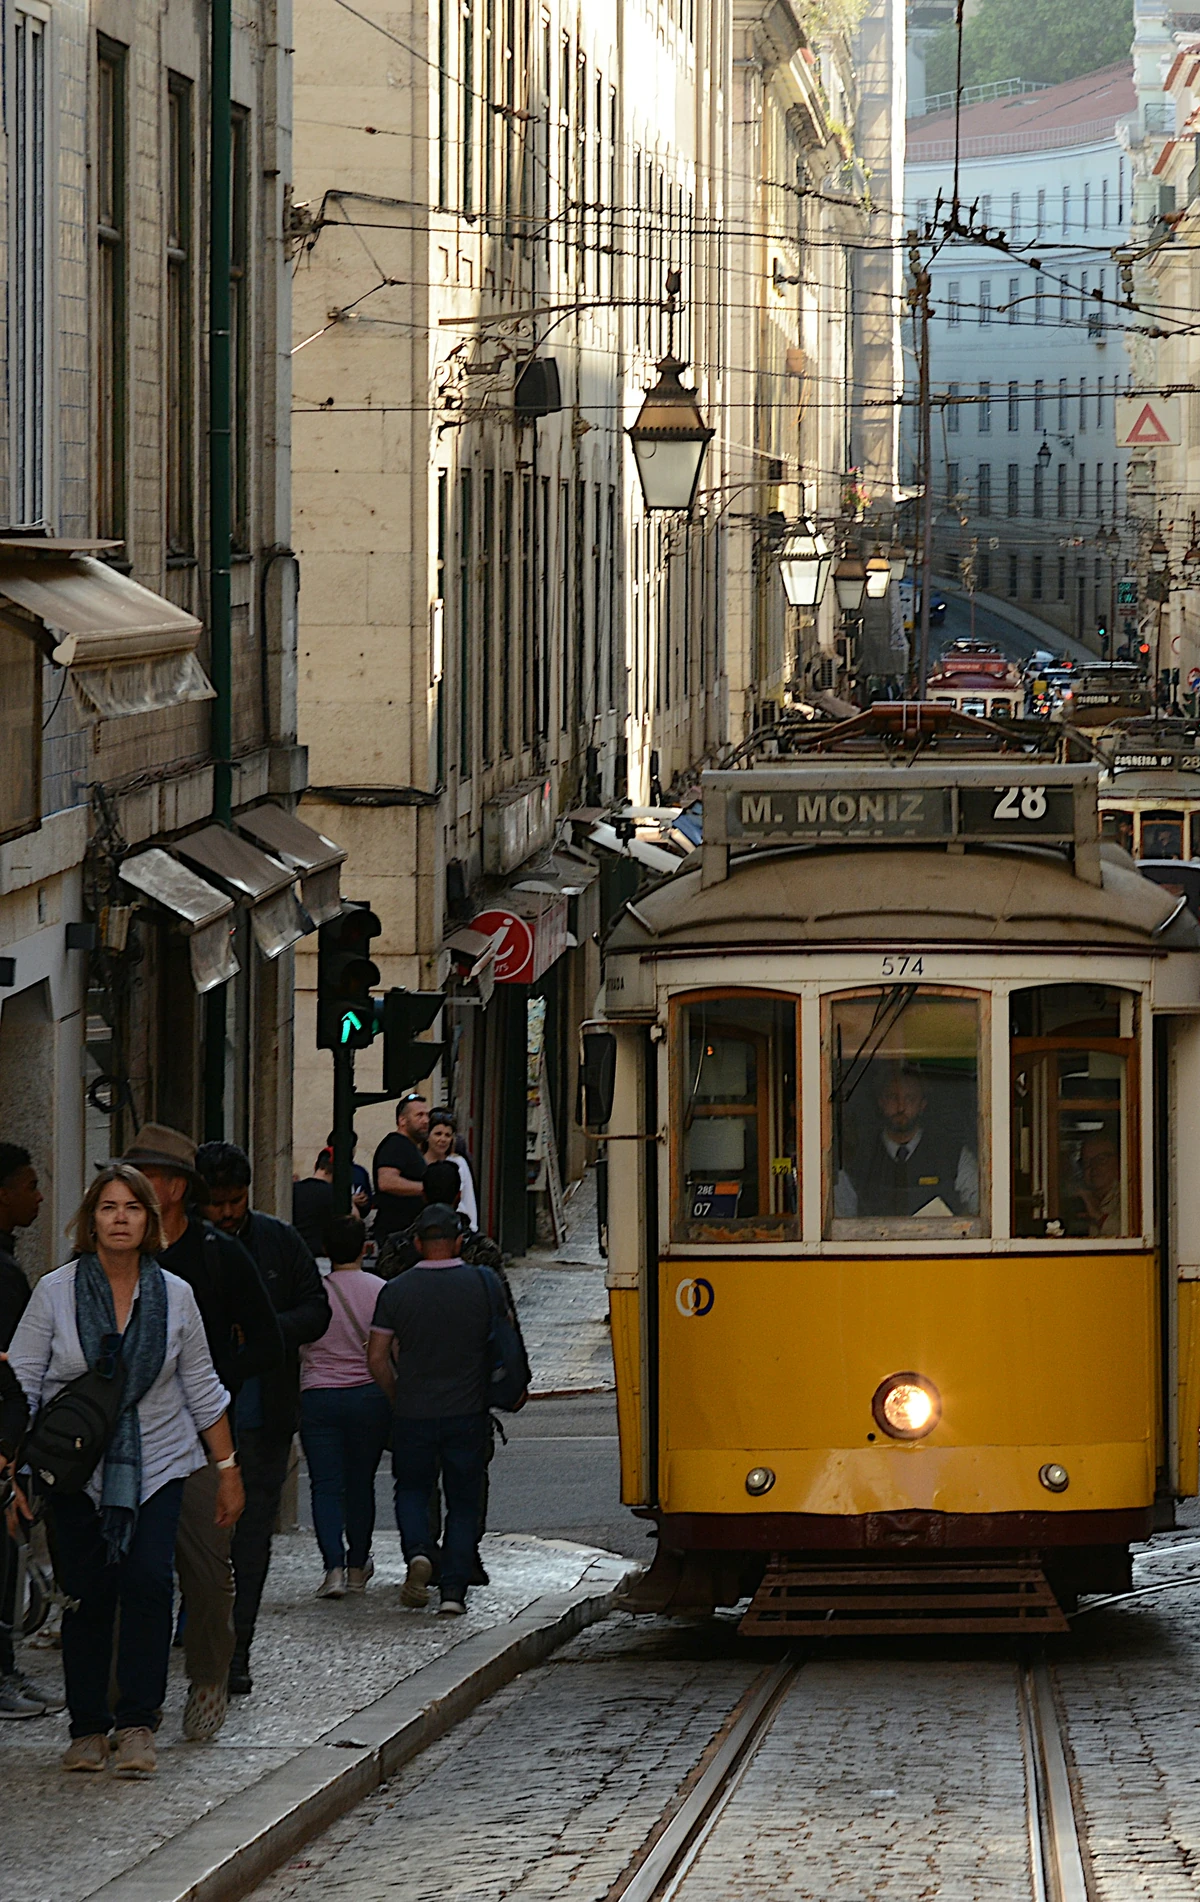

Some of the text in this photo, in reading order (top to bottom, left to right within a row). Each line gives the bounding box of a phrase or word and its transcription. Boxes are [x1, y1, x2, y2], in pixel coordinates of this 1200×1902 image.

[741, 786, 1047, 824] M. MONIZ 28
[881, 956, 925, 976] 574
[696, 1184, 715, 1196] 28E
[693, 1202, 712, 1217] 07
